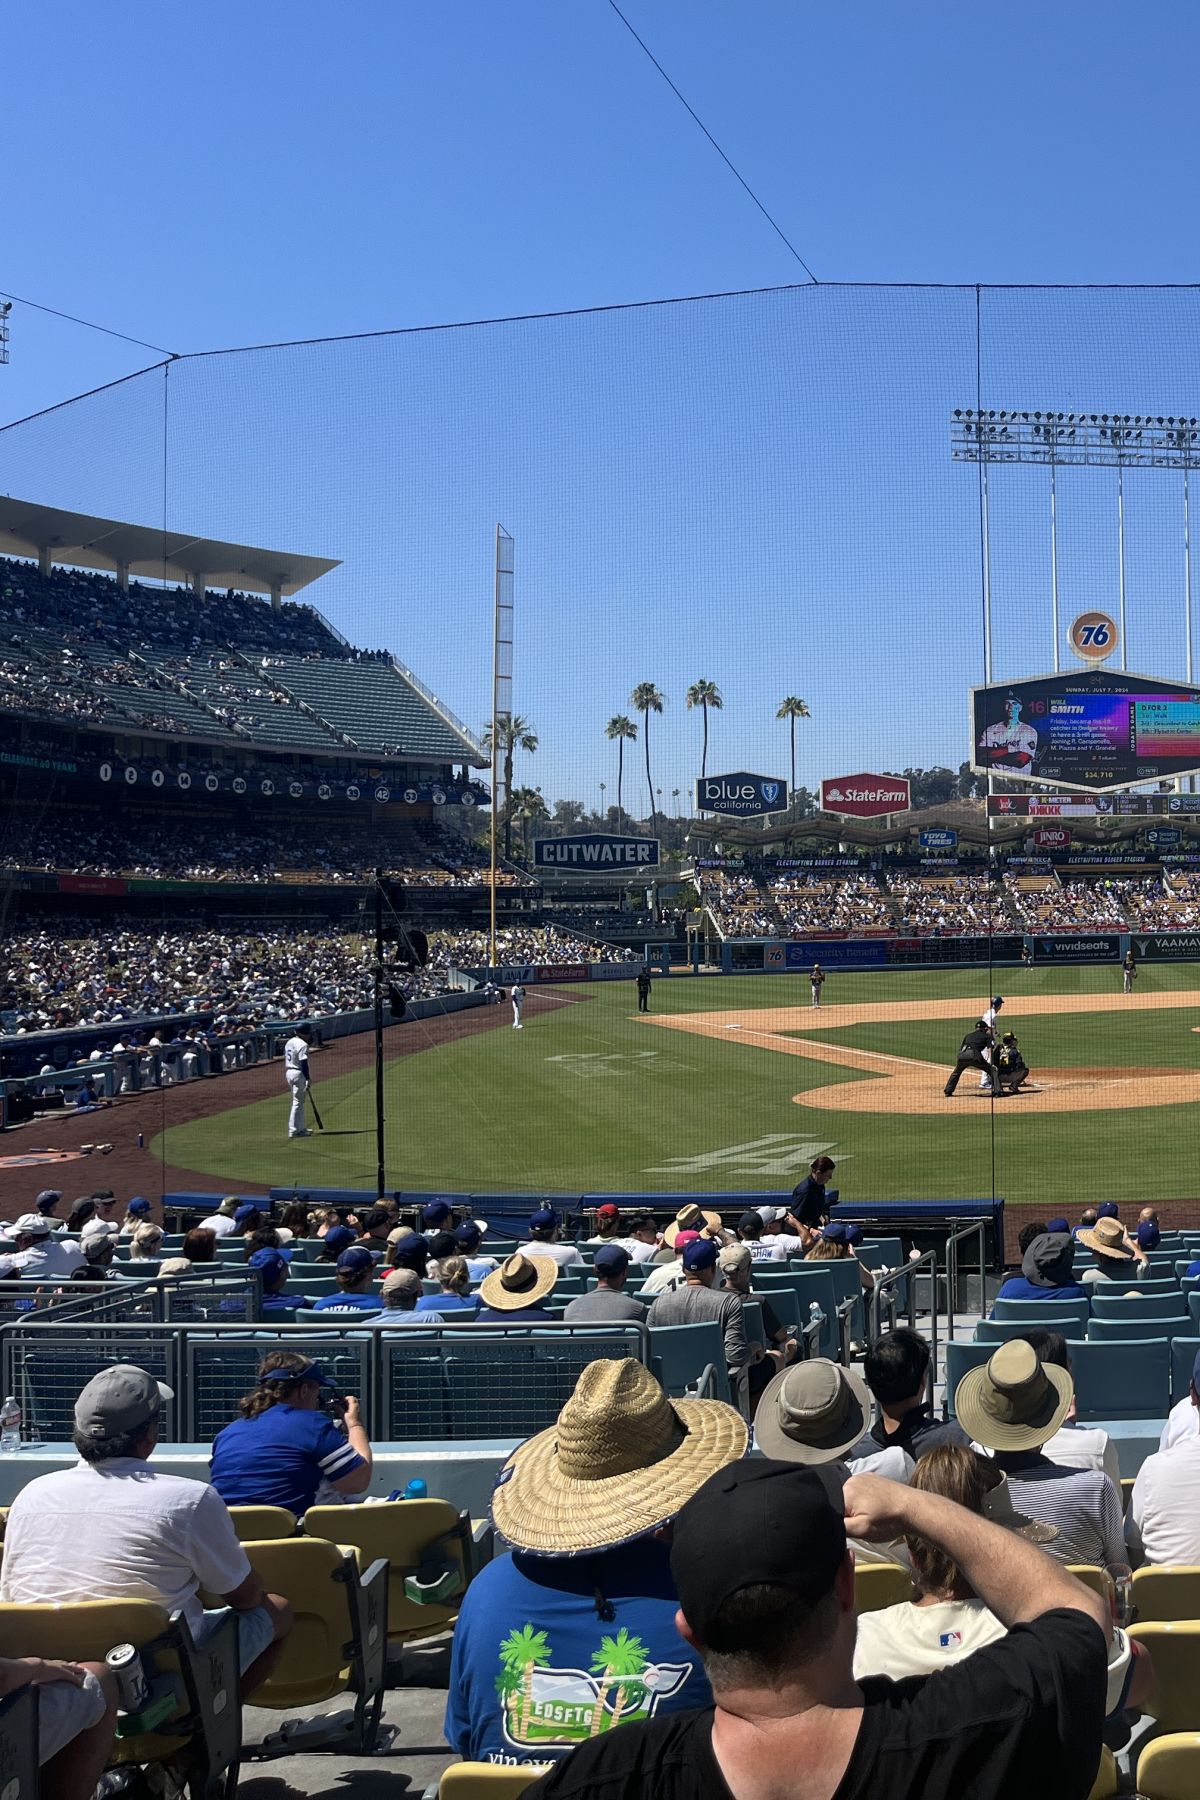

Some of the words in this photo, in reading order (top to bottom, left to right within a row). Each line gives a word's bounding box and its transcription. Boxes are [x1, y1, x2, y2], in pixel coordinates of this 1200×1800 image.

[1080, 623, 1110, 647] 76
[1028, 701, 1045, 714] 16
[1050, 705, 1085, 714] SMITH
[52, 761, 77, 773] YEARS
[103, 767, 108, 777] 1
[128, 770, 134, 780] 2
[155, 773, 161, 783] 4
[180, 776, 189, 786] 14
[208, 778, 217, 788] 19
[235, 781, 245, 791] 20
[263, 782, 273, 792] 24
[291, 785, 302, 795] 32
[705, 781, 755, 800] blue
[319, 787, 330, 798] 34
[348, 788, 358, 797] 39
[377, 790, 388, 800] 42
[406, 791, 416, 801] 53
[713, 800, 762, 809] california
[1040, 831, 1065, 844] JINRO
[542, 844, 651, 862] CUTWATER
[1055, 941, 1109, 951] vividseats
[768, 952, 783, 961] 76
[803, 948, 845, 959] Security
[534, 1701, 593, 1724] EDSFTG
